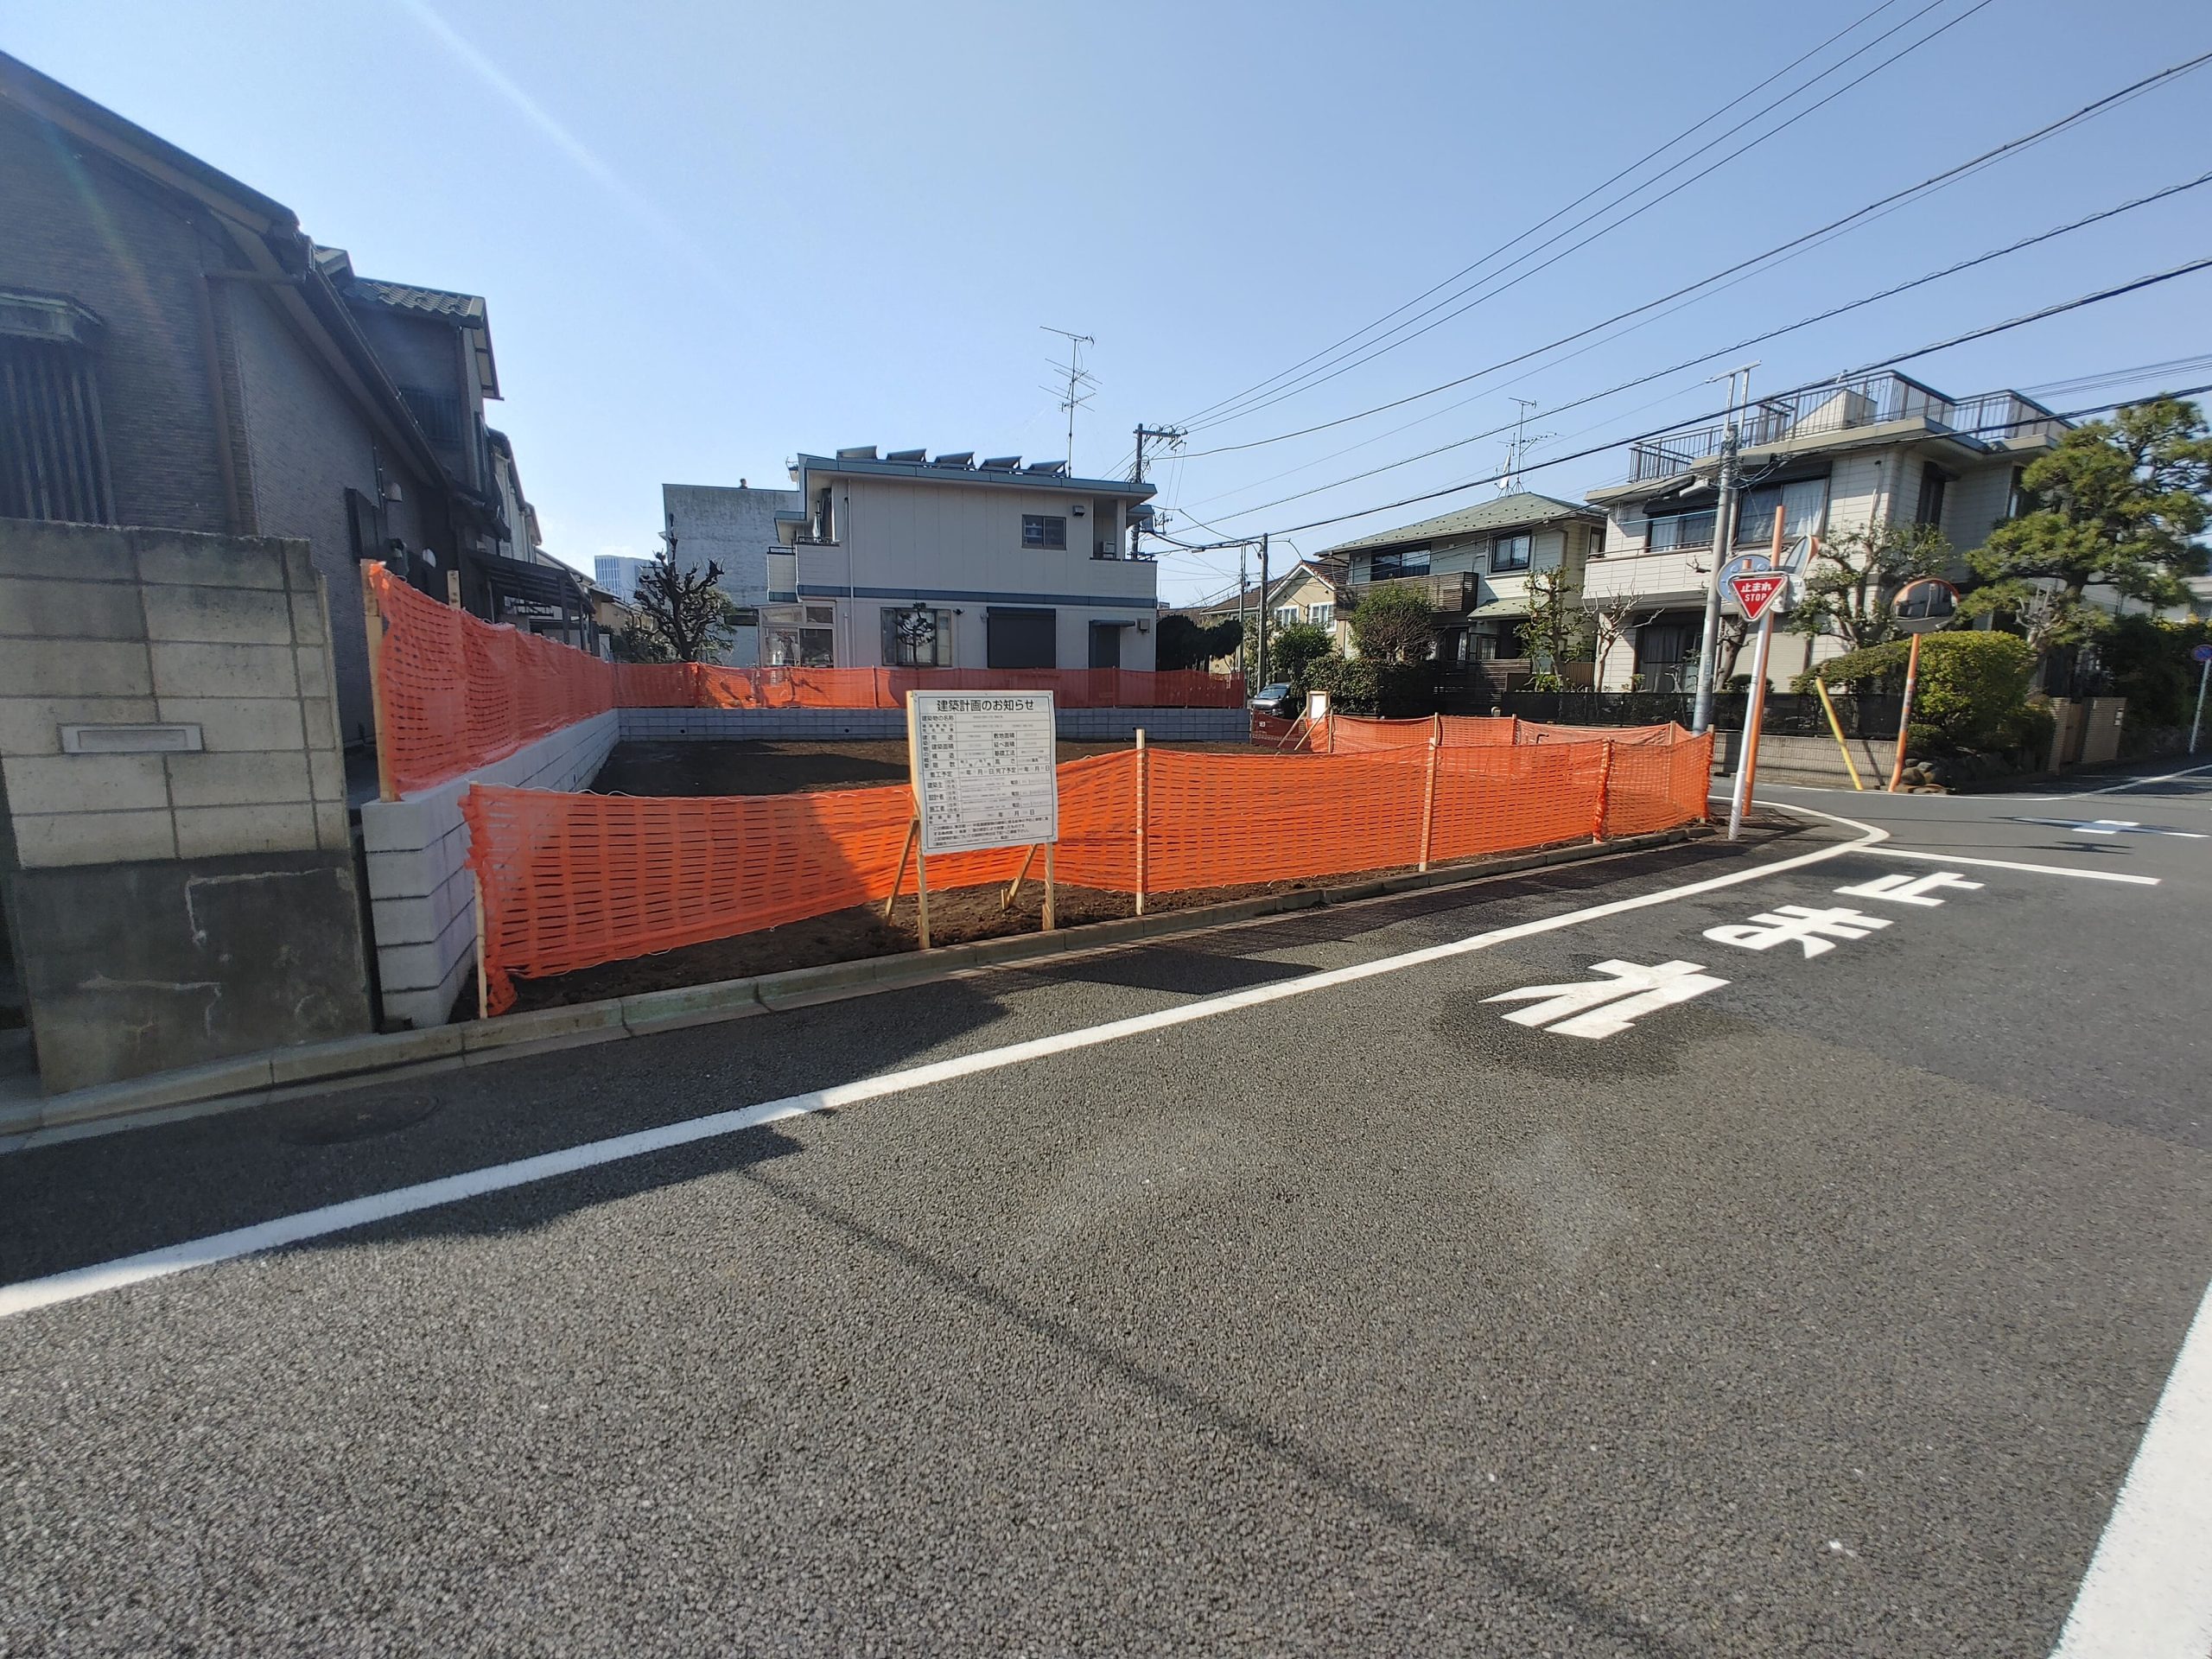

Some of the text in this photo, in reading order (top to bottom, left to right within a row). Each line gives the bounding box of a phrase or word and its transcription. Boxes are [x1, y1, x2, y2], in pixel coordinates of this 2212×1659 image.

[1740, 582, 1772, 593] 止まれ
[937, 699, 1034, 712] 建築計画のお知らせ
[1478, 871, 1986, 1039] 止まれ
